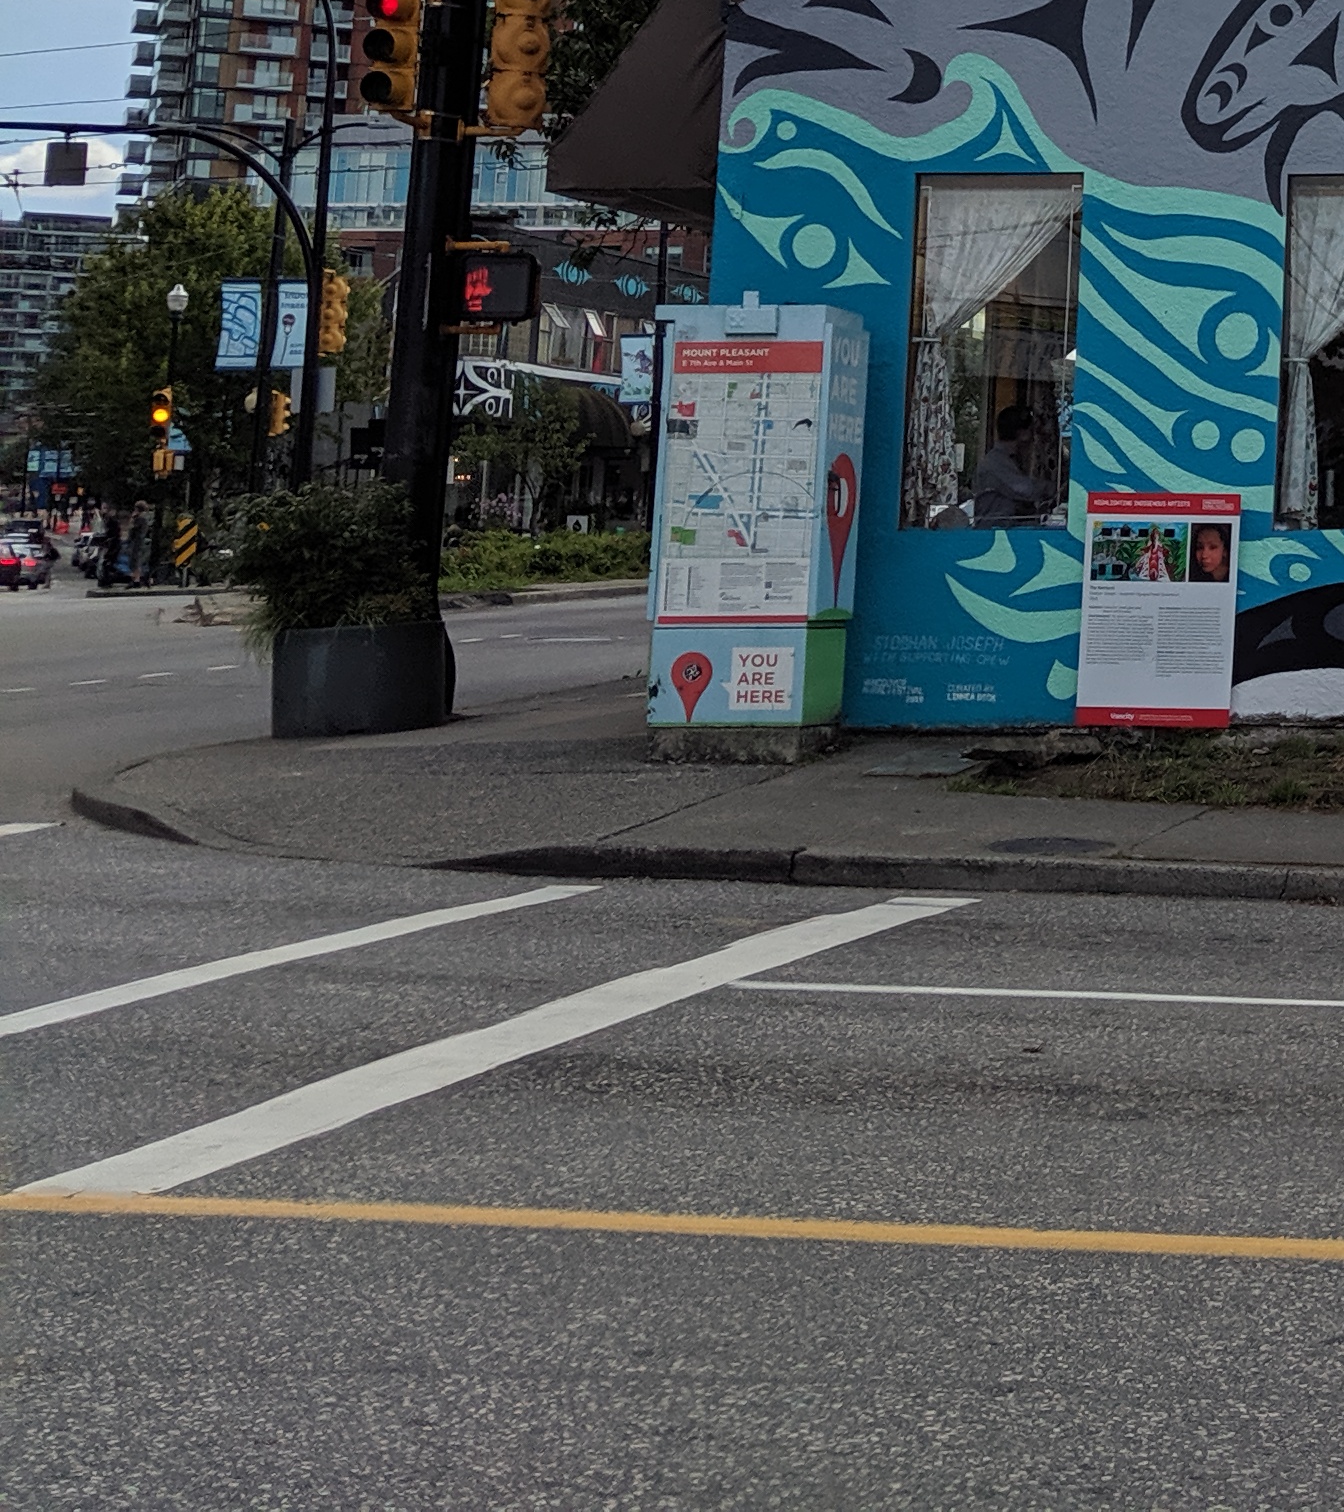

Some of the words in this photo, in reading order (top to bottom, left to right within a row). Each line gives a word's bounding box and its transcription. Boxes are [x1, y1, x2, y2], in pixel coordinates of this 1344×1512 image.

[682, 348, 718, 357] MOUNT
[720, 348, 770, 357] PLEASANT
[831, 336, 860, 367] YOU
[830, 374, 858, 406] ARE
[828, 413, 863, 445] HERE
[946, 635, 1006, 652] JOSEPH
[739, 654, 778, 667] YOU
[737, 672, 775, 686] ARE
[736, 690, 785, 704] HERE
